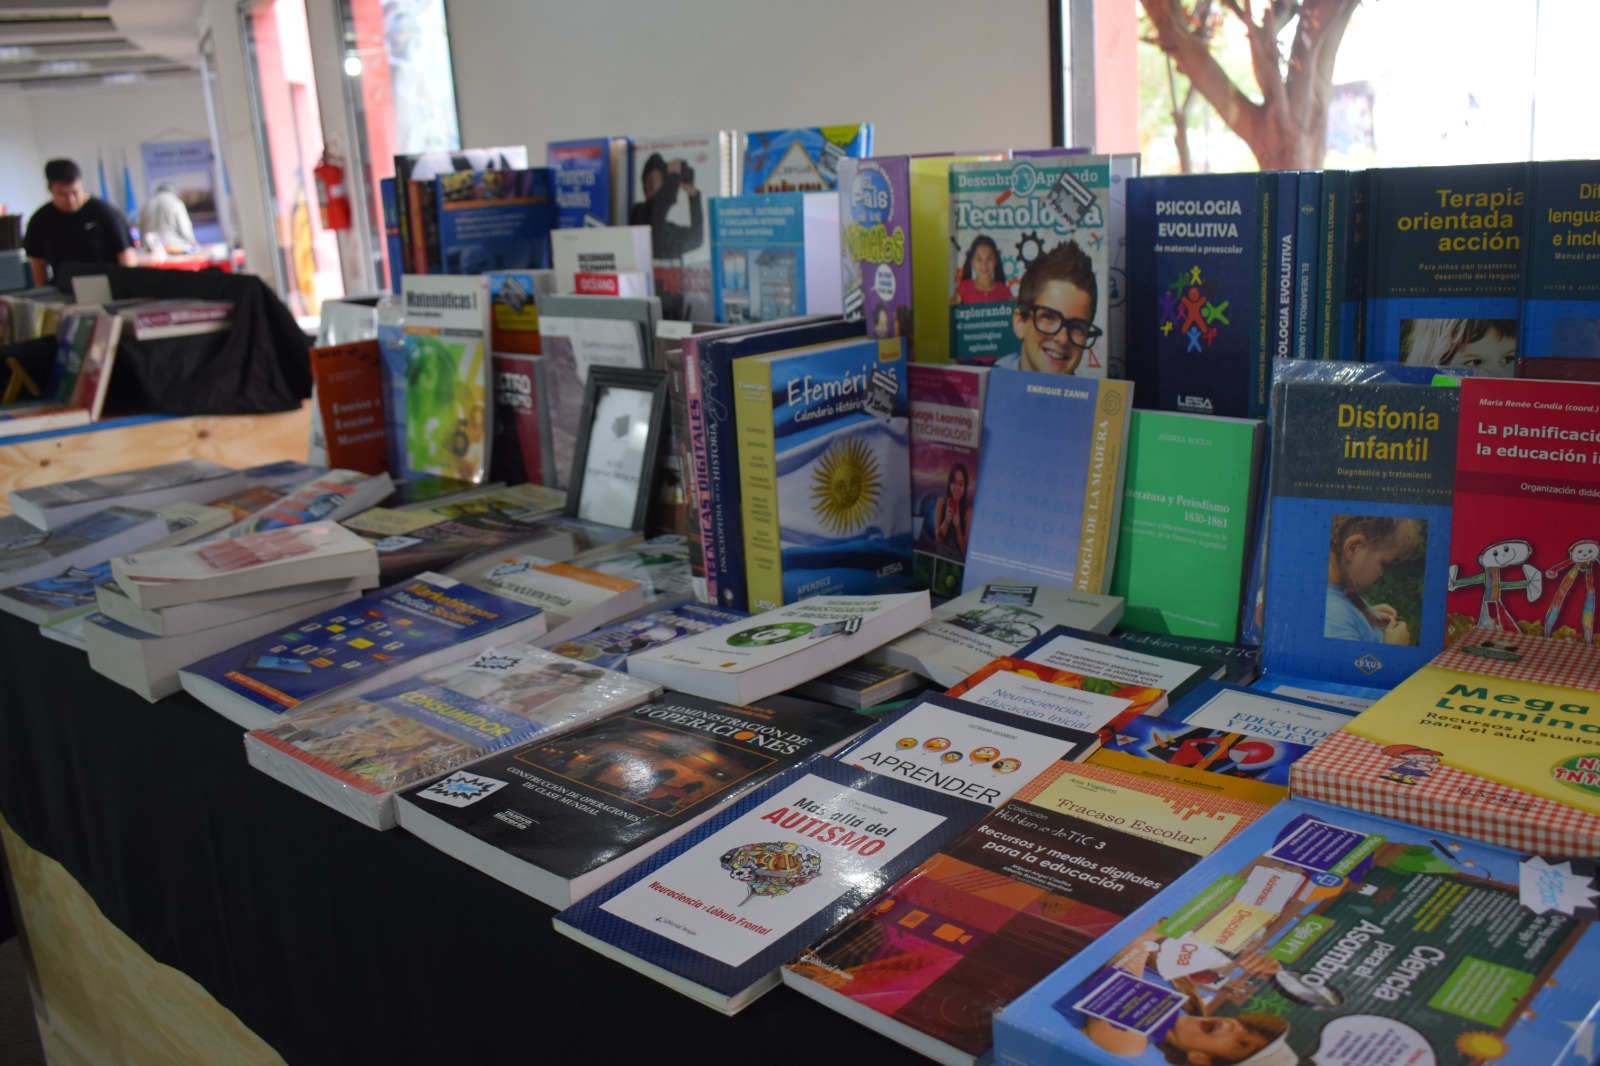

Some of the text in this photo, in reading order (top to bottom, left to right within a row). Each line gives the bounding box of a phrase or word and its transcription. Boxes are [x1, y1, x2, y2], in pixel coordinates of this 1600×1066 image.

[1155, 200, 1242, 217] PSICOLOGIA
[1436, 188, 1524, 211] Terapia
[1158, 222, 1239, 238] EVOLUTIVA
[1397, 211, 1514, 231] orientada
[1154, 244, 1243, 255] de maternal preescolar
[1438, 232, 1520, 251] acción
[1552, 234, 1562, 246] e
[1438, 262, 1459, 270] niños
[1555, 252, 1584, 260] Manual
[1280, 233, 1292, 304] EVOLUTIVA
[1434, 272, 1472, 280] desarrollo
[1475, 272, 1486, 280] del
[956, 305, 1012, 320] Explorando
[1300, 275, 1308, 332] DESARROLLO
[1027, 384, 1089, 399] ENRIQUE ZANNI
[1177, 395, 1212, 407] LESA
[1337, 403, 1440, 431] Disfonía
[1479, 398, 1599, 413] María Renée Candia (coord.)
[935, 411, 972, 428] Learning
[1478, 421, 1498, 436] La
[708, 423, 721, 481] HISTORIA
[1091, 420, 1109, 488] MADERA
[1343, 435, 1429, 462] infantil
[1476, 442, 1588, 465] la educación
[1337, 466, 1432, 480] Diagnóstico tratamiento
[1089, 490, 1100, 511] LA
[1520, 482, 1576, 496] Organización
[1168, 494, 1230, 513] y Periodismo
[1086, 513, 1097, 535] DE
[1183, 510, 1228, 528] 1830-1861
[1043, 657, 1100, 677] necesidades
[1102, 670, 1153, 687] especiales
[1048, 653, 1071, 665] para
[1072, 657, 1106, 672] educar
[1113, 666, 1139, 679] niños
[1140, 674, 1159, 683] con
[1054, 649, 1110, 667] Herramientas
[1111, 660, 1164, 679] psicológicas
[1354, 658, 1383, 670] LEXUS
[992, 688, 1085, 717] Neurociencias
[1445, 683, 1590, 715] Mega
[398, 691, 511, 738] CONSUMIDOR
[664, 703, 785, 739] ADMINISTRACIÓN
[785, 730, 812, 747] DE
[977, 696, 1092, 731] Educación Inicial
[1225, 719, 1239, 728] Y
[1426, 711, 1514, 733] Recursos
[1418, 718, 1536, 743] para el aula
[506, 766, 569, 799] CONSTRUCCIÓN
[861, 750, 1002, 804] APRENDER
[1068, 777, 1084, 787] Ana
[521, 781, 600, 817] DE CLASE MUNDIAL
[793, 797, 897, 838] Más allá del
[1007, 803, 1050, 821] Colección
[760, 806, 886, 857] AUTISMO
[1094, 839, 1107, 850] 3
[977, 823, 1163, 890] Recursos y medios digitales
[981, 838, 1125, 894] para la educación
[649, 879, 773, 936] Neurociencia Lóbulo Frontal
[1215, 908, 1253, 946] Descubre
[1294, 920, 1324, 945] Caja
[1176, 943, 1199, 967] Crea
[1300, 918, 1386, 987] Asombro
[1353, 939, 1396, 980] para el
[1372, 944, 1446, 1001] Ciencia
